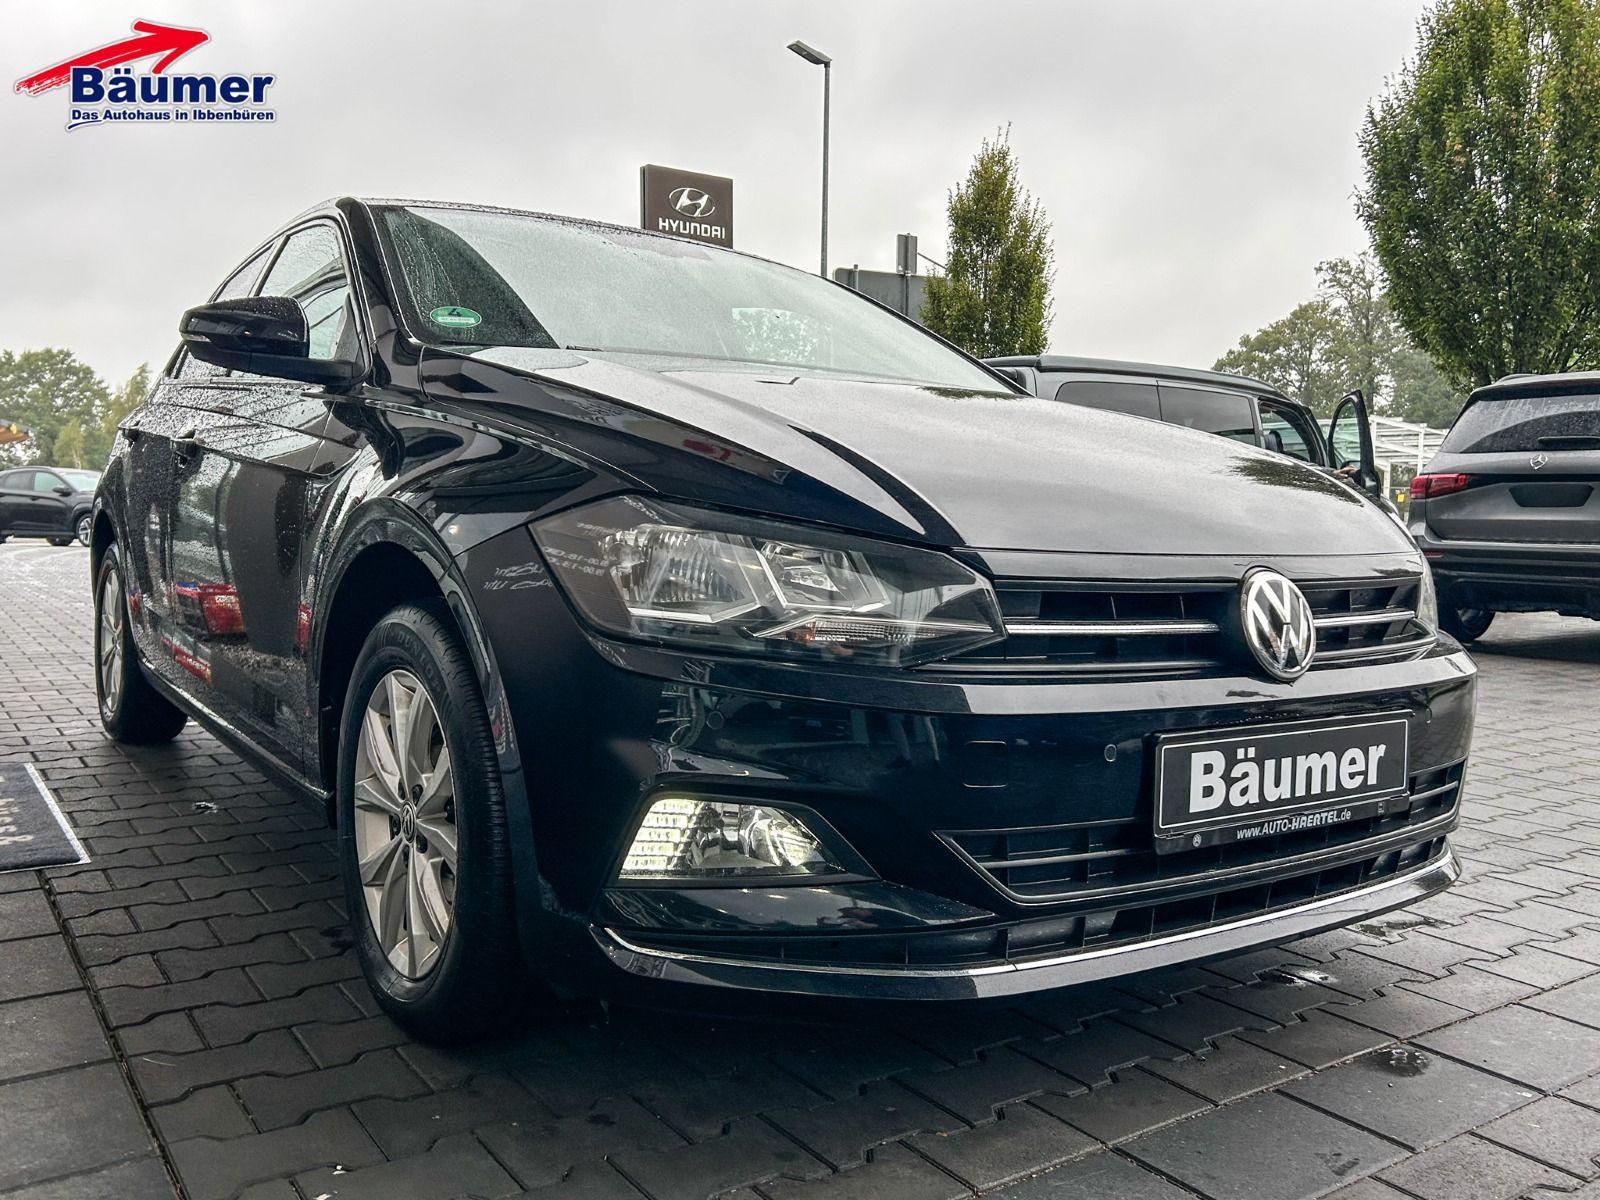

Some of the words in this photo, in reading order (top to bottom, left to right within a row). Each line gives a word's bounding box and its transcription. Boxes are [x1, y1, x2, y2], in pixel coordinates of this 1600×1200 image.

[658, 217, 726, 240] HYUNDAI
[1188, 743, 1387, 813] Bäumer
[1236, 808, 1352, 840] www.AUTO-HAERTEL.de
